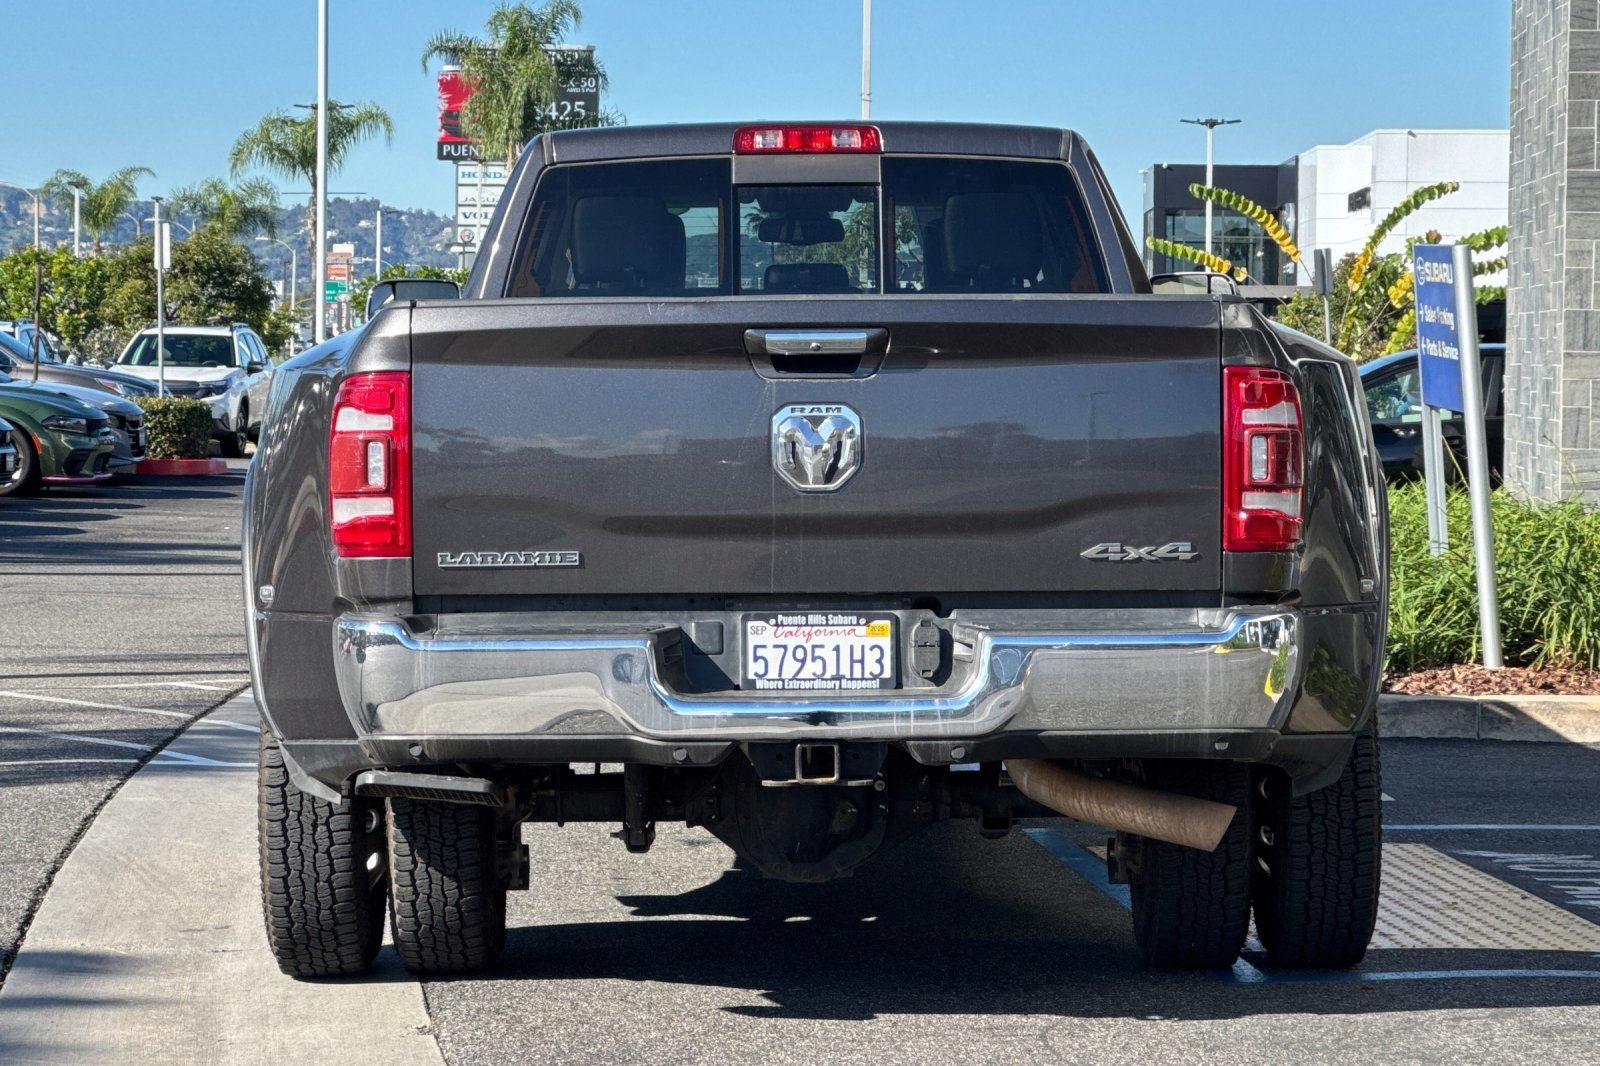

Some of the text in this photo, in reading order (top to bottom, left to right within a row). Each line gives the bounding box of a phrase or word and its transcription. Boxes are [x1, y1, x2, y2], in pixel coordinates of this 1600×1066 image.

[443, 144, 485, 157] PUEN
[1425, 261, 1453, 284] SUBARU
[1424, 304, 1437, 323] Sales
[1426, 338, 1438, 357] Parts
[1442, 341, 1459, 360] Service
[438, 551, 579, 567] LARAMIE
[777, 614, 857, 625] Puente Hills Subaru
[750, 625, 767, 635] SEP
[773, 625, 858, 643] California
[753, 645, 885, 679] 57951H3
[756, 679, 880, 690] Where Extraordinary Happens!
